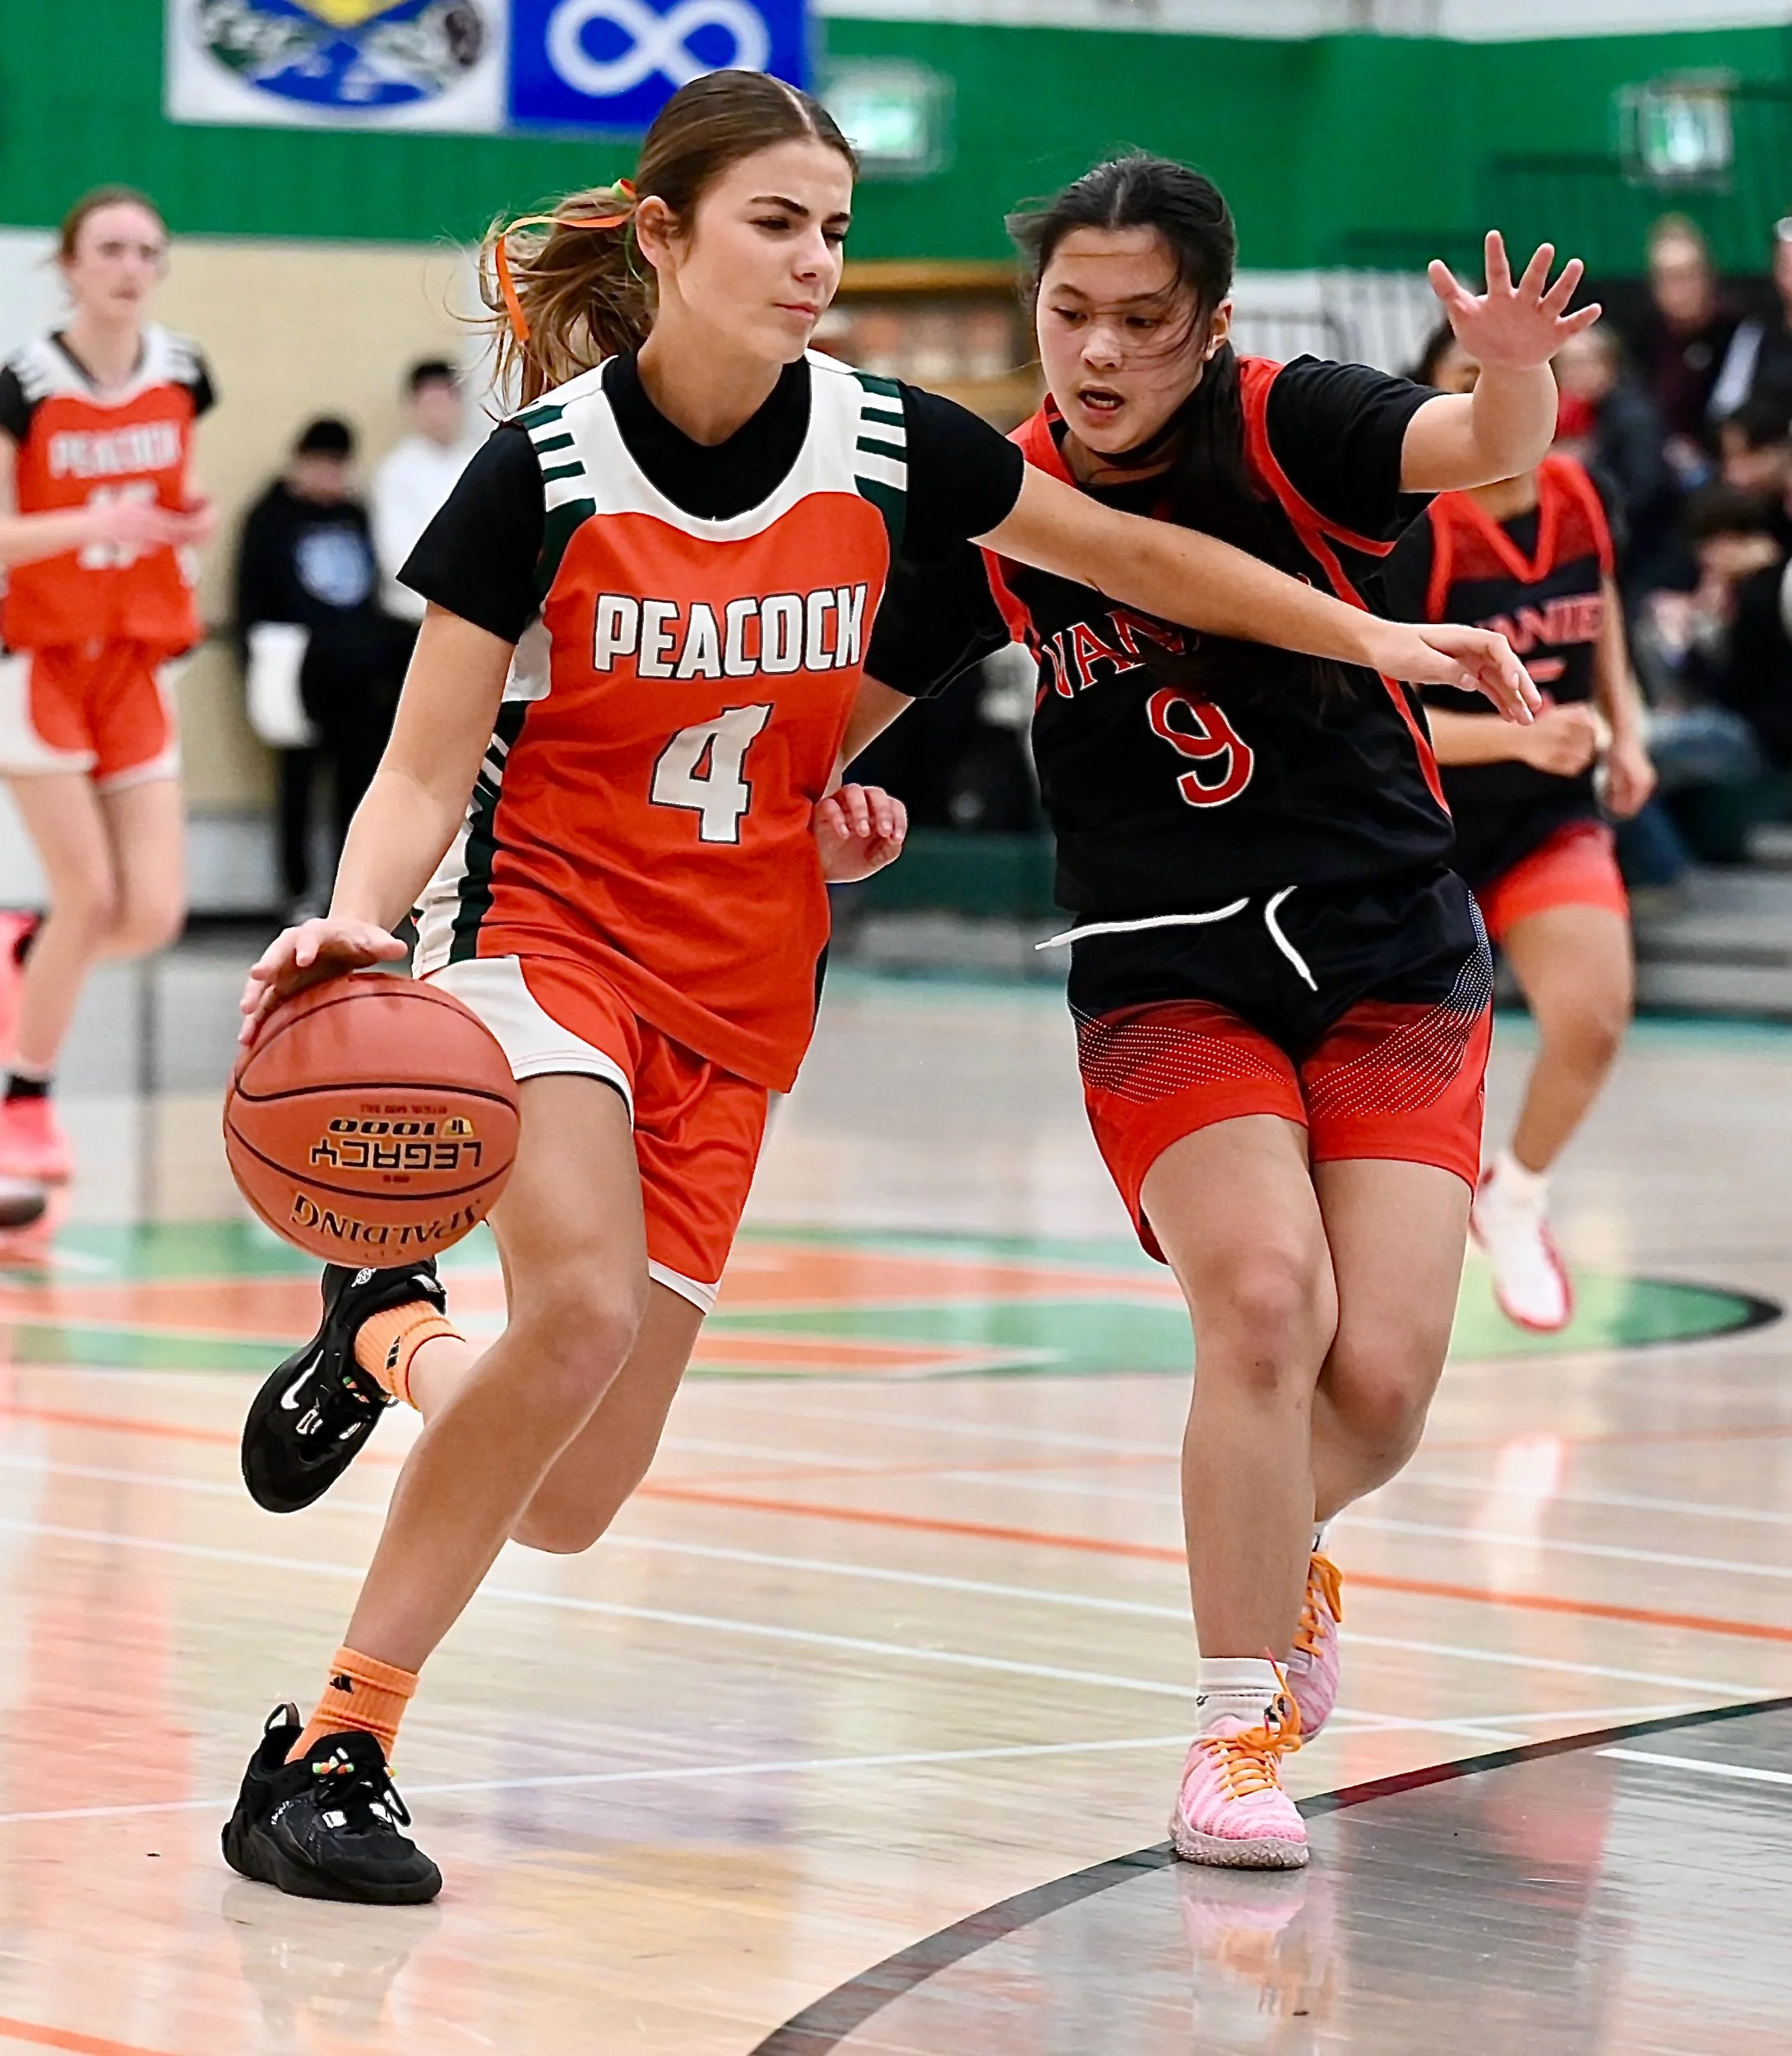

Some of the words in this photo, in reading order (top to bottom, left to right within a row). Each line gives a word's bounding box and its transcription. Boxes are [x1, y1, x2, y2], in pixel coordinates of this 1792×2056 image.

[594, 582, 868, 680] PEACOCK
[649, 702, 774, 845] 4
[1146, 687, 1254, 808] 9
[309, 1138, 483, 1169] LEGACY
[328, 1118, 437, 1136] 1000
